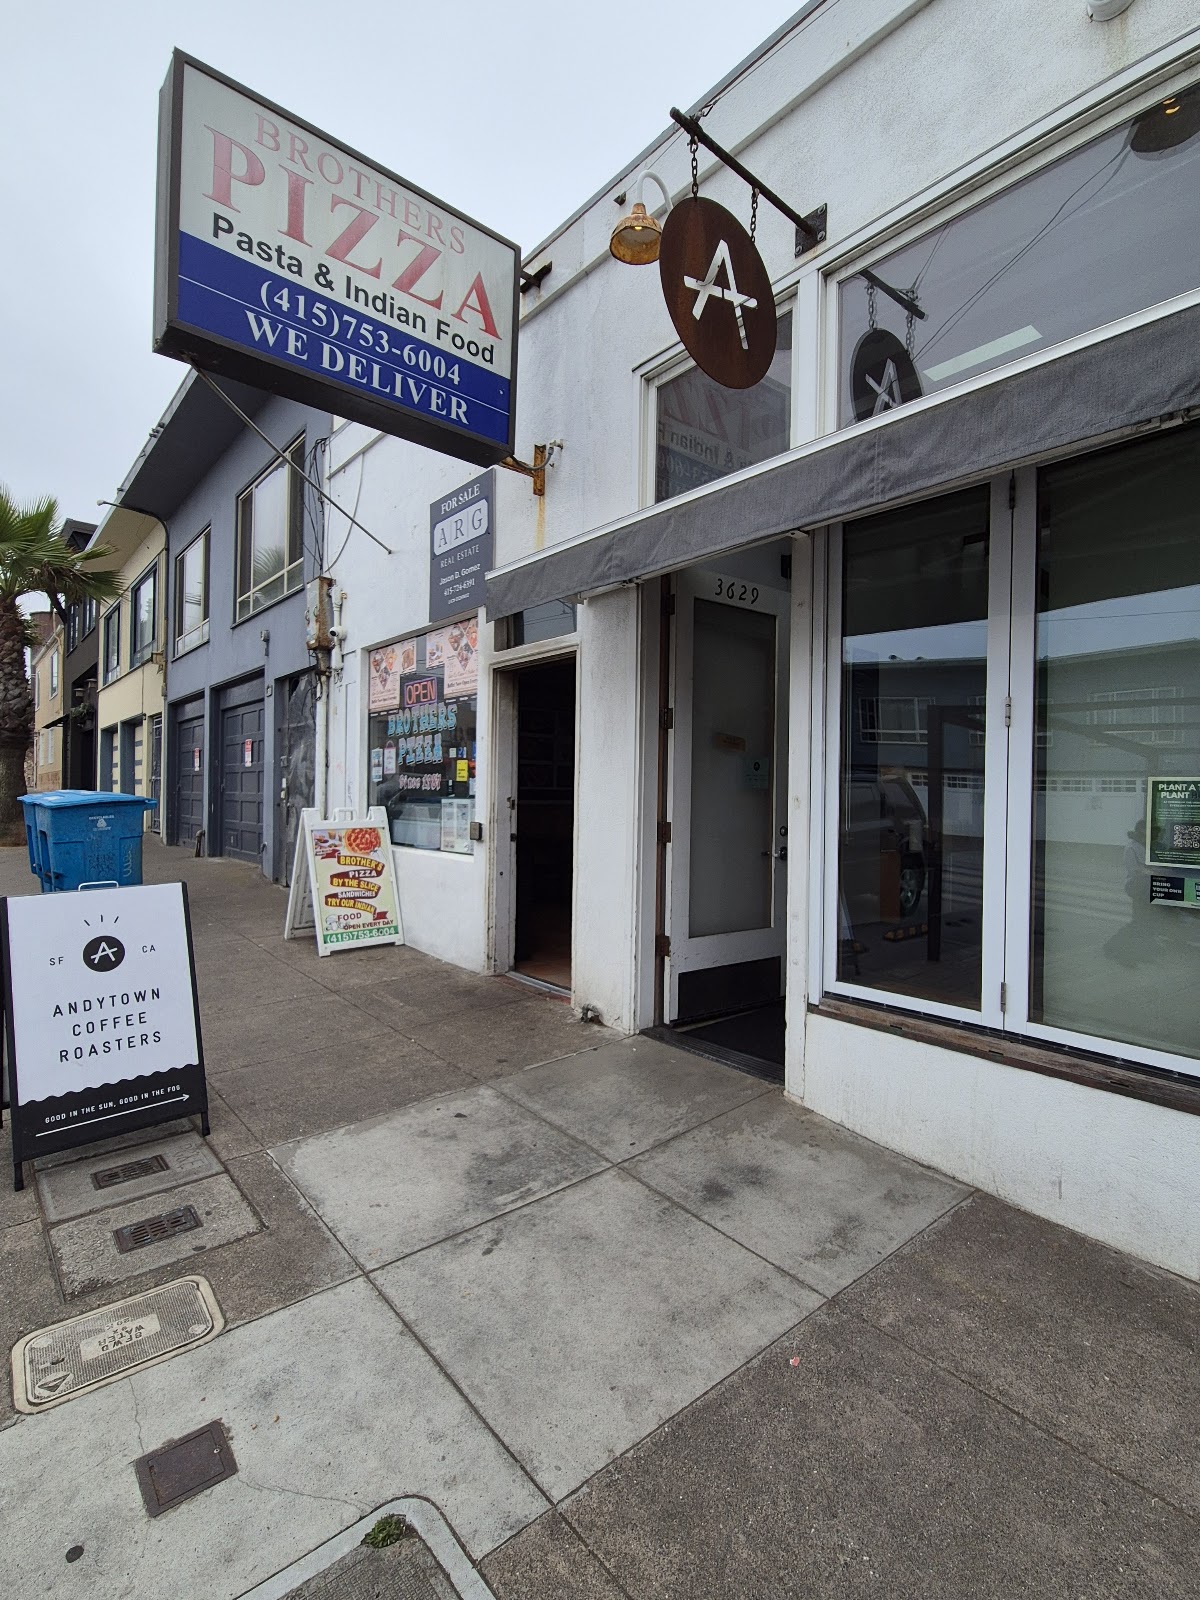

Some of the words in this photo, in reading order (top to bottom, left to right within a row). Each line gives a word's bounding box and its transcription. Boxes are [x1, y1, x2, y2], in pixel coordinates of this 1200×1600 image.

[254, 112, 466, 255] BROTHERS
[202, 124, 503, 341] PIZZA
[212, 211, 303, 278] Pasta
[314, 262, 335, 291] &
[345, 275, 427, 334] Indian
[435, 320, 495, 365] Food
[260, 279, 461, 386] (415)753-6004
[243, 308, 308, 361] WE
[320, 339, 470, 425] DELIVER
[441, 497, 458, 515] FOR
[458, 483, 481, 505] SALE
[440, 554, 455, 569] REAL
[457, 544, 480, 561] ESTATE
[714, 577, 760, 605] 3629
[406, 680, 436, 704] OPEN
[388, 702, 458, 737] BROTHERS
[397, 733, 443, 766] PIZZA
[1158, 783, 1187, 791] PLANT
[1189, 783, 1197, 791] A
[1160, 791, 1190, 799] PLANT
[340, 856, 383, 871] BROTHER'S
[349, 870, 377, 878] PIZZA
[332, 877, 344, 886] BY
[344, 878, 358, 887] THE
[360, 880, 379, 892] SLICE
[337, 890, 376, 898] SANDWICHES
[327, 898, 341, 906] TRY
[341, 899, 354, 908] OUR
[355, 900, 375, 914] INDIAN
[337, 912, 362, 922] FOOD
[343, 922, 361, 931] OPEN
[362, 920, 381, 929] EVERY
[49, 956, 64, 966] SF
[141, 944, 156, 953] CA
[53, 987, 160, 1018] ANDYTOWN
[72, 1011, 147, 1036] COFFEE
[59, 1031, 161, 1063] ROASTERS
[45, 1113, 66, 1124] GOOD
[69, 1109, 78, 1118] IN
[81, 1105, 96, 1115] THE
[98, 1101, 117, 1111] SUN,
[119, 1095, 138, 1105] GOOD
[141, 1092, 149, 1100] IN
[151, 1088, 165, 1097] THE
[167, 1084, 181, 1093] FOG
